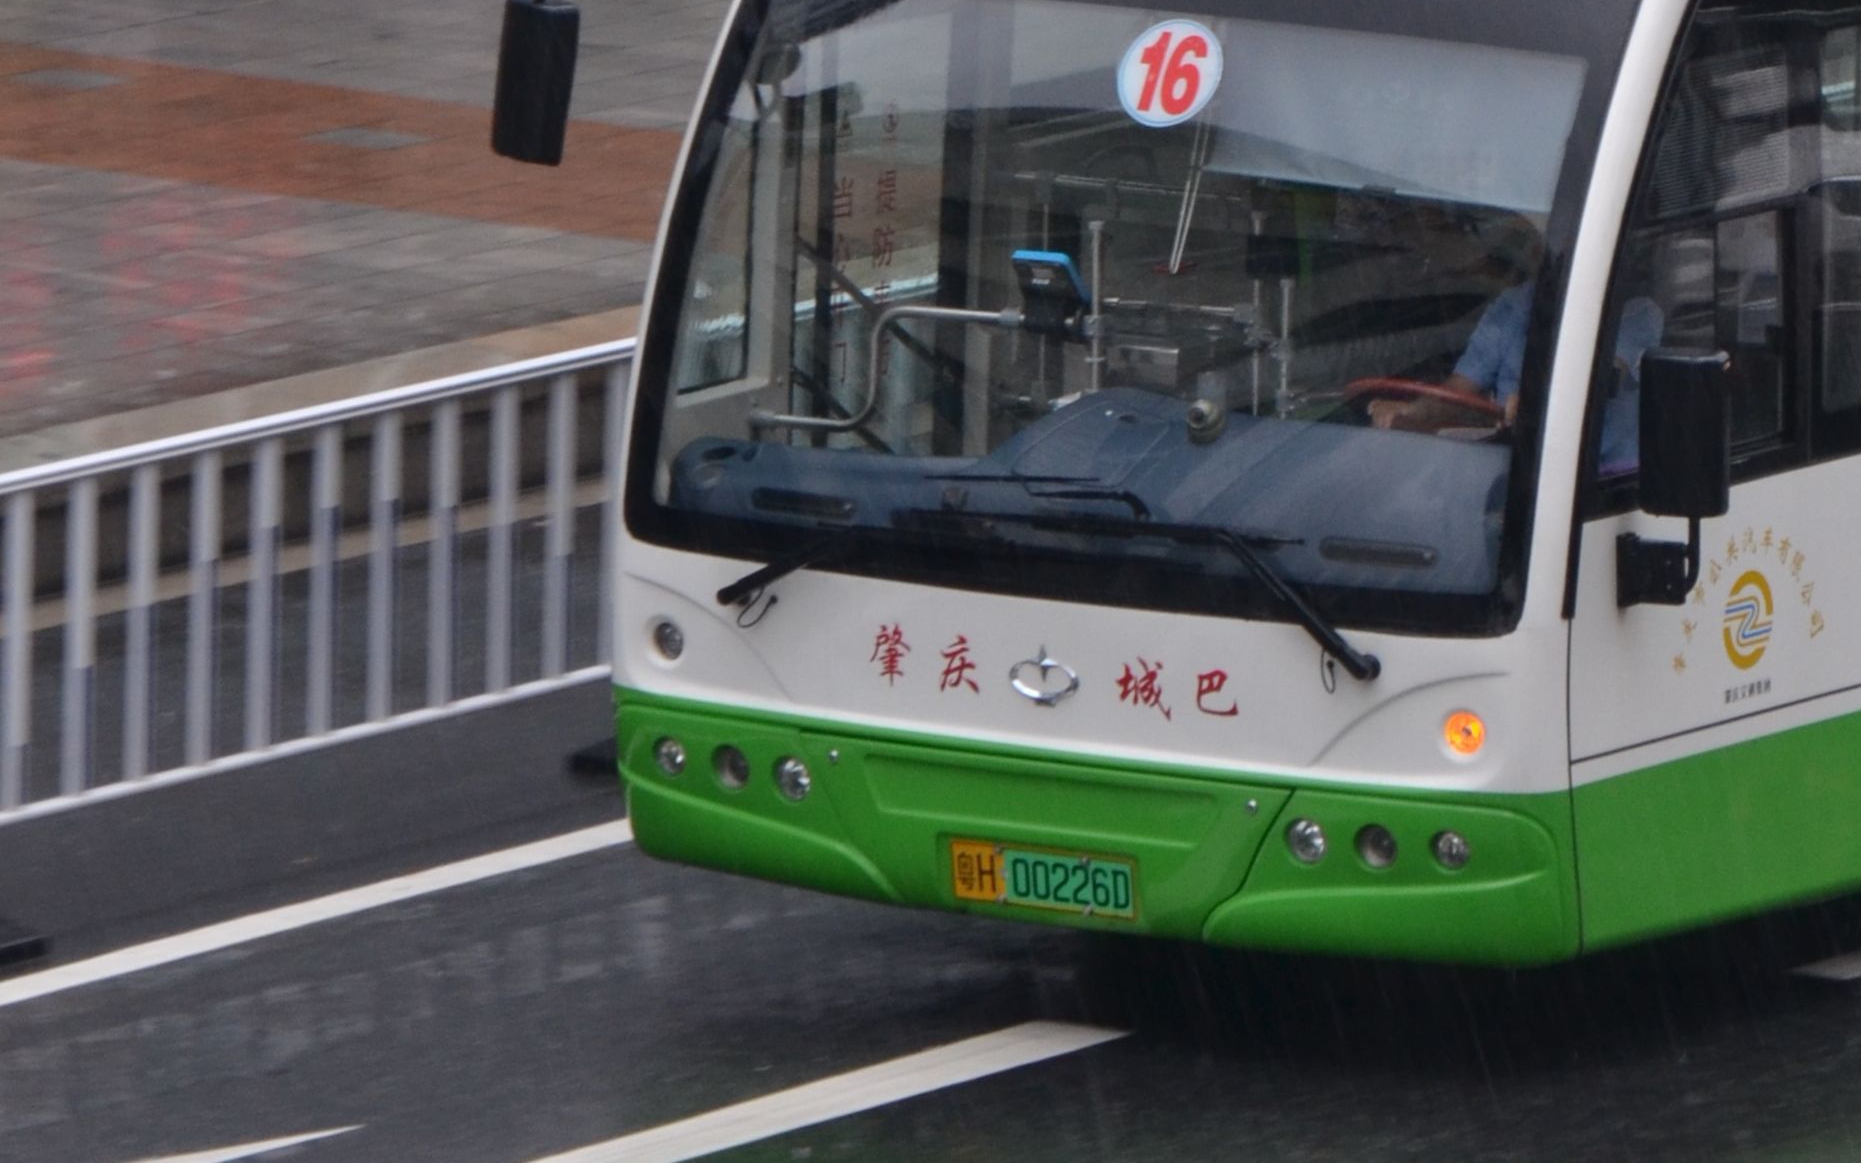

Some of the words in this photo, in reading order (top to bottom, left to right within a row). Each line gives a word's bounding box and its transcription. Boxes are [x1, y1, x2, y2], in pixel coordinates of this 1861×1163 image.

[1136, 31, 1209, 116] 16
[870, 623, 980, 695] 肇庆
[1115, 655, 1240, 721] 城巴
